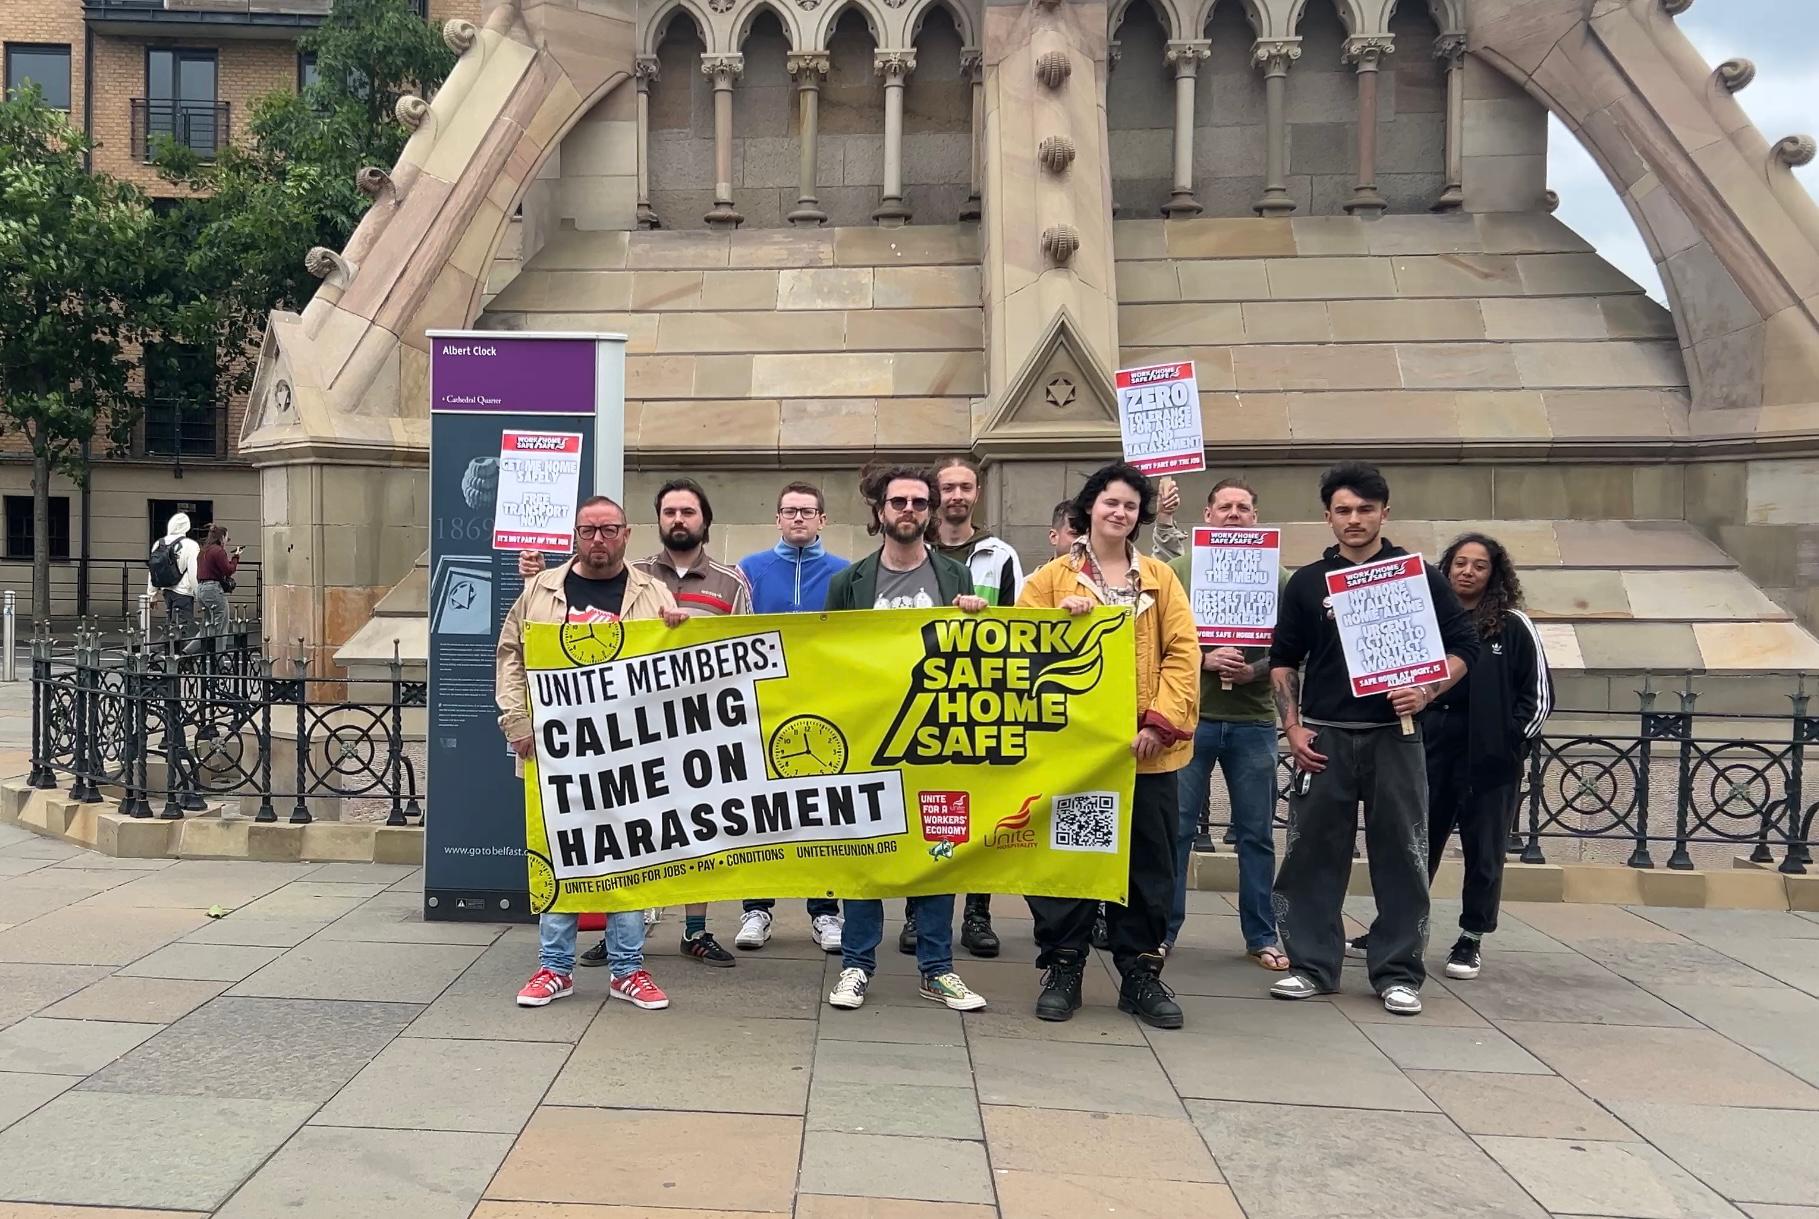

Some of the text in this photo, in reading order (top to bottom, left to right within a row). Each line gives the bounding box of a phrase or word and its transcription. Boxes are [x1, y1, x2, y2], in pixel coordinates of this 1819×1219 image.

[443, 345, 497, 356] Albert Clock
[447, 395, 501, 405] Cathedral Quarter
[1126, 382, 1188, 413] ZERO
[1128, 406, 1191, 424] TOLERANCE
[1130, 416, 1192, 435] FOR ABUSE
[1151, 430, 1174, 442] AND
[1126, 436, 1200, 456] HARASSMENT
[502, 458, 577, 474] GET ME HOME
[517, 471, 560, 484] SAFELY
[522, 492, 550, 504] FREE
[503, 502, 569, 518] TRANSPORT
[437, 517, 495, 541] 1869
[521, 515, 549, 528] NOW
[1211, 549, 1261, 561] WE ARE
[1213, 559, 1258, 572] NOT ON
[1206, 570, 1268, 584] THE MENU
[1345, 570, 1370, 580] WORK
[1195, 590, 1274, 604] RESPECT FOR
[1348, 581, 1407, 600] NO MORE
[1195, 601, 1274, 615] HOSPITALITY
[1351, 590, 1410, 612] WALKING
[1204, 612, 1265, 625] WORKERS
[1343, 598, 1424, 626] HOME ALONE
[1361, 617, 1412, 638] URGENT
[934, 620, 1072, 653] WORK
[1357, 626, 1425, 651] ACTION TO
[1363, 640, 1421, 660] PROTECT
[1361, 648, 1430, 672] WORKERS
[536, 637, 778, 707] UNITE MEMBERS:
[923, 658, 1030, 689] SAFE
[1359, 678, 1377, 687] SAFE
[543, 687, 748, 759] CALLING
[917, 726, 1026, 757] SAFE
[548, 742, 748, 814] TIME ON
[921, 795, 947, 804] UNITE
[923, 805, 940, 814] FOR
[941, 805, 948, 813] A
[557, 781, 886, 867] HARASSMENT
[924, 815, 968, 824] WORKERS'
[926, 826, 967, 835] ECONOMY
[565, 840, 897, 895] UNITE FIGHTING FOR JOBS PAY CONDITIONS UNITETHEUNION.ORG
